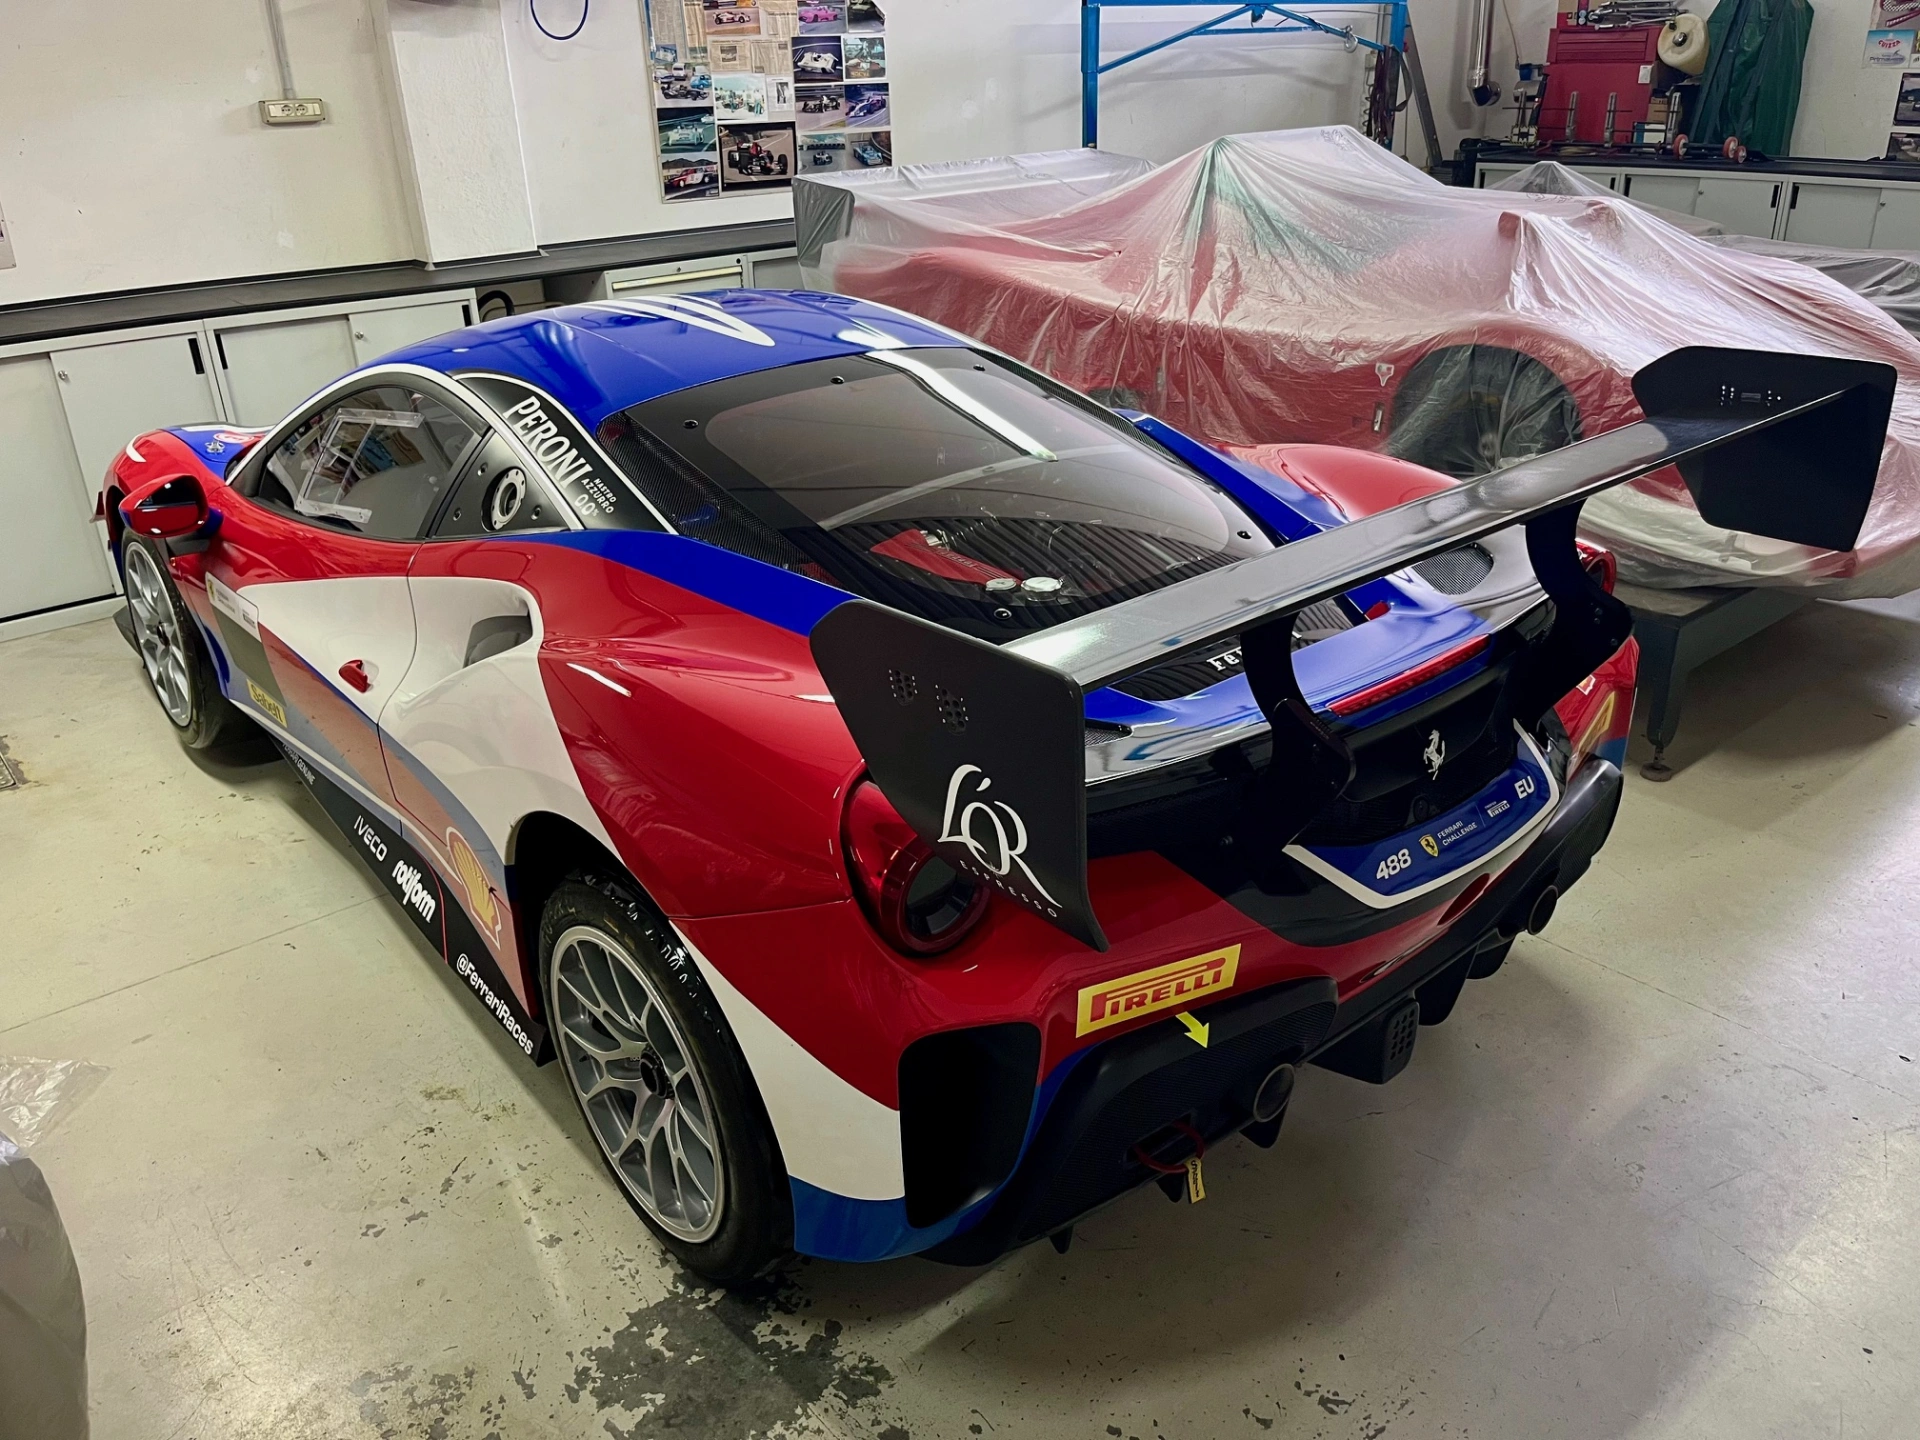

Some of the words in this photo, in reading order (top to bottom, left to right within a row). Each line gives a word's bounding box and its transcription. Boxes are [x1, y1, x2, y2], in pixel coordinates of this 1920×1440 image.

[502, 395, 593, 489] PERONI
[580, 478, 615, 514] AZZURRO
[593, 477, 617, 502] NASTRO
[1514, 775, 1535, 800] EU
[353, 814, 388, 863] IVECO
[1437, 820, 1463, 839] FERRARI
[1442, 821, 1478, 846] CHALLENGE
[1375, 848, 1412, 881] 488
[391, 859, 437, 924] rotiform
[455, 952, 534, 1056] @FerrariRaces
[1090, 956, 1227, 1024] PIRELLI
